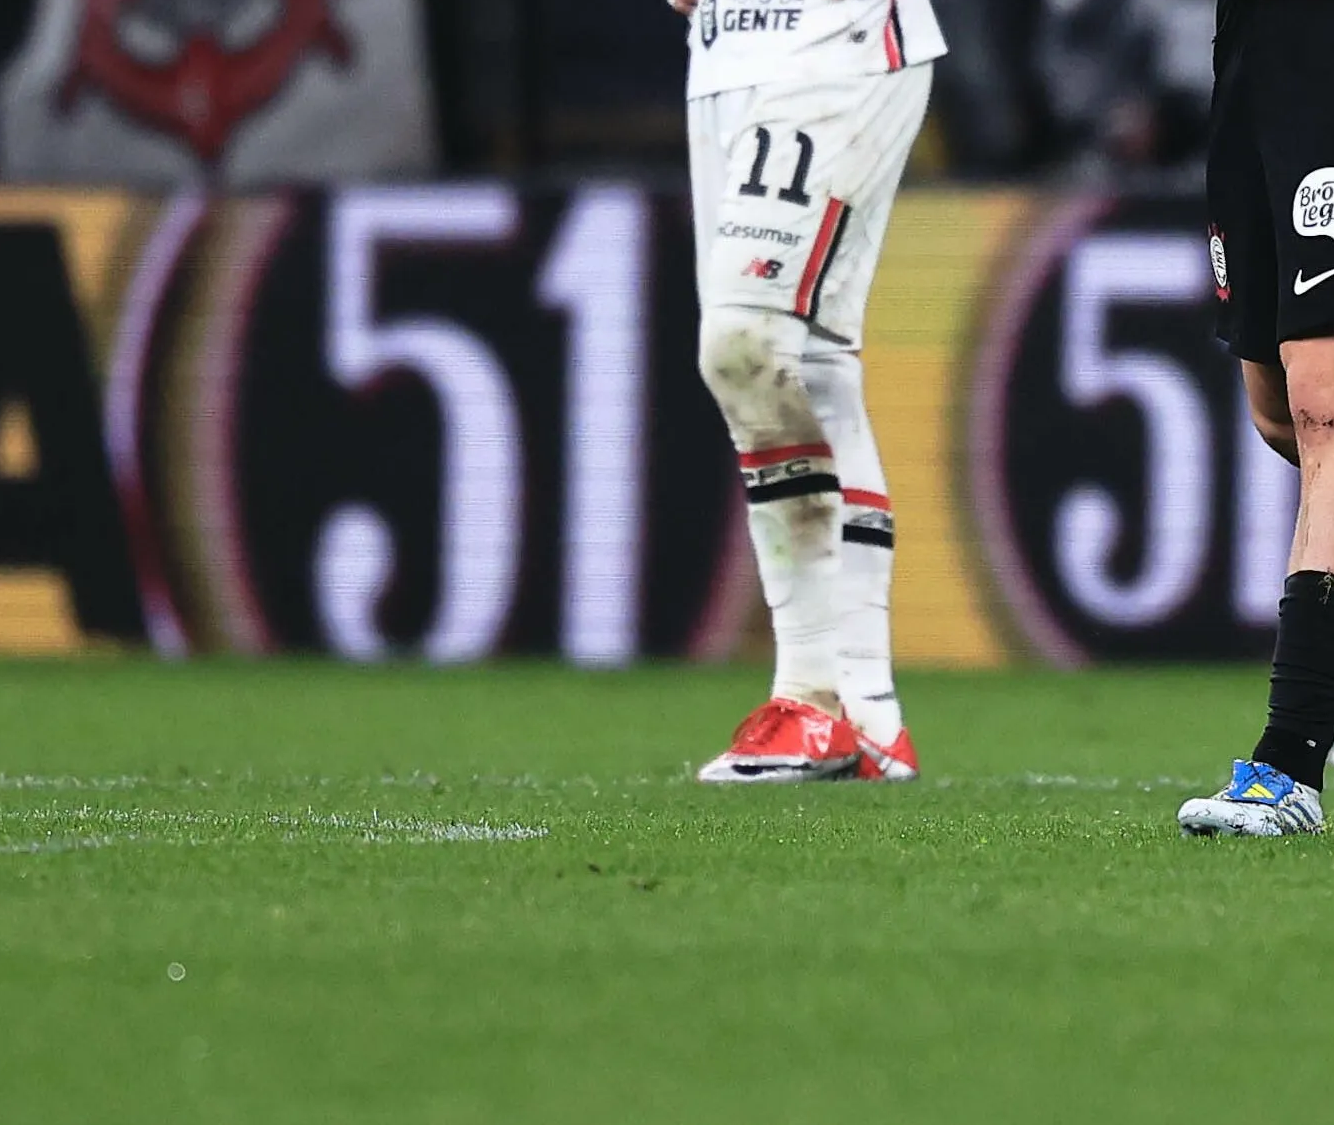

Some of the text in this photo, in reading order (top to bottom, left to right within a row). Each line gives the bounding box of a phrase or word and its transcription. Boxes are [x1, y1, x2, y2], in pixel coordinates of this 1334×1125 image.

[723, 8, 803, 32] GENTE
[739, 125, 815, 208] 11
[313, 181, 649, 665] 51
